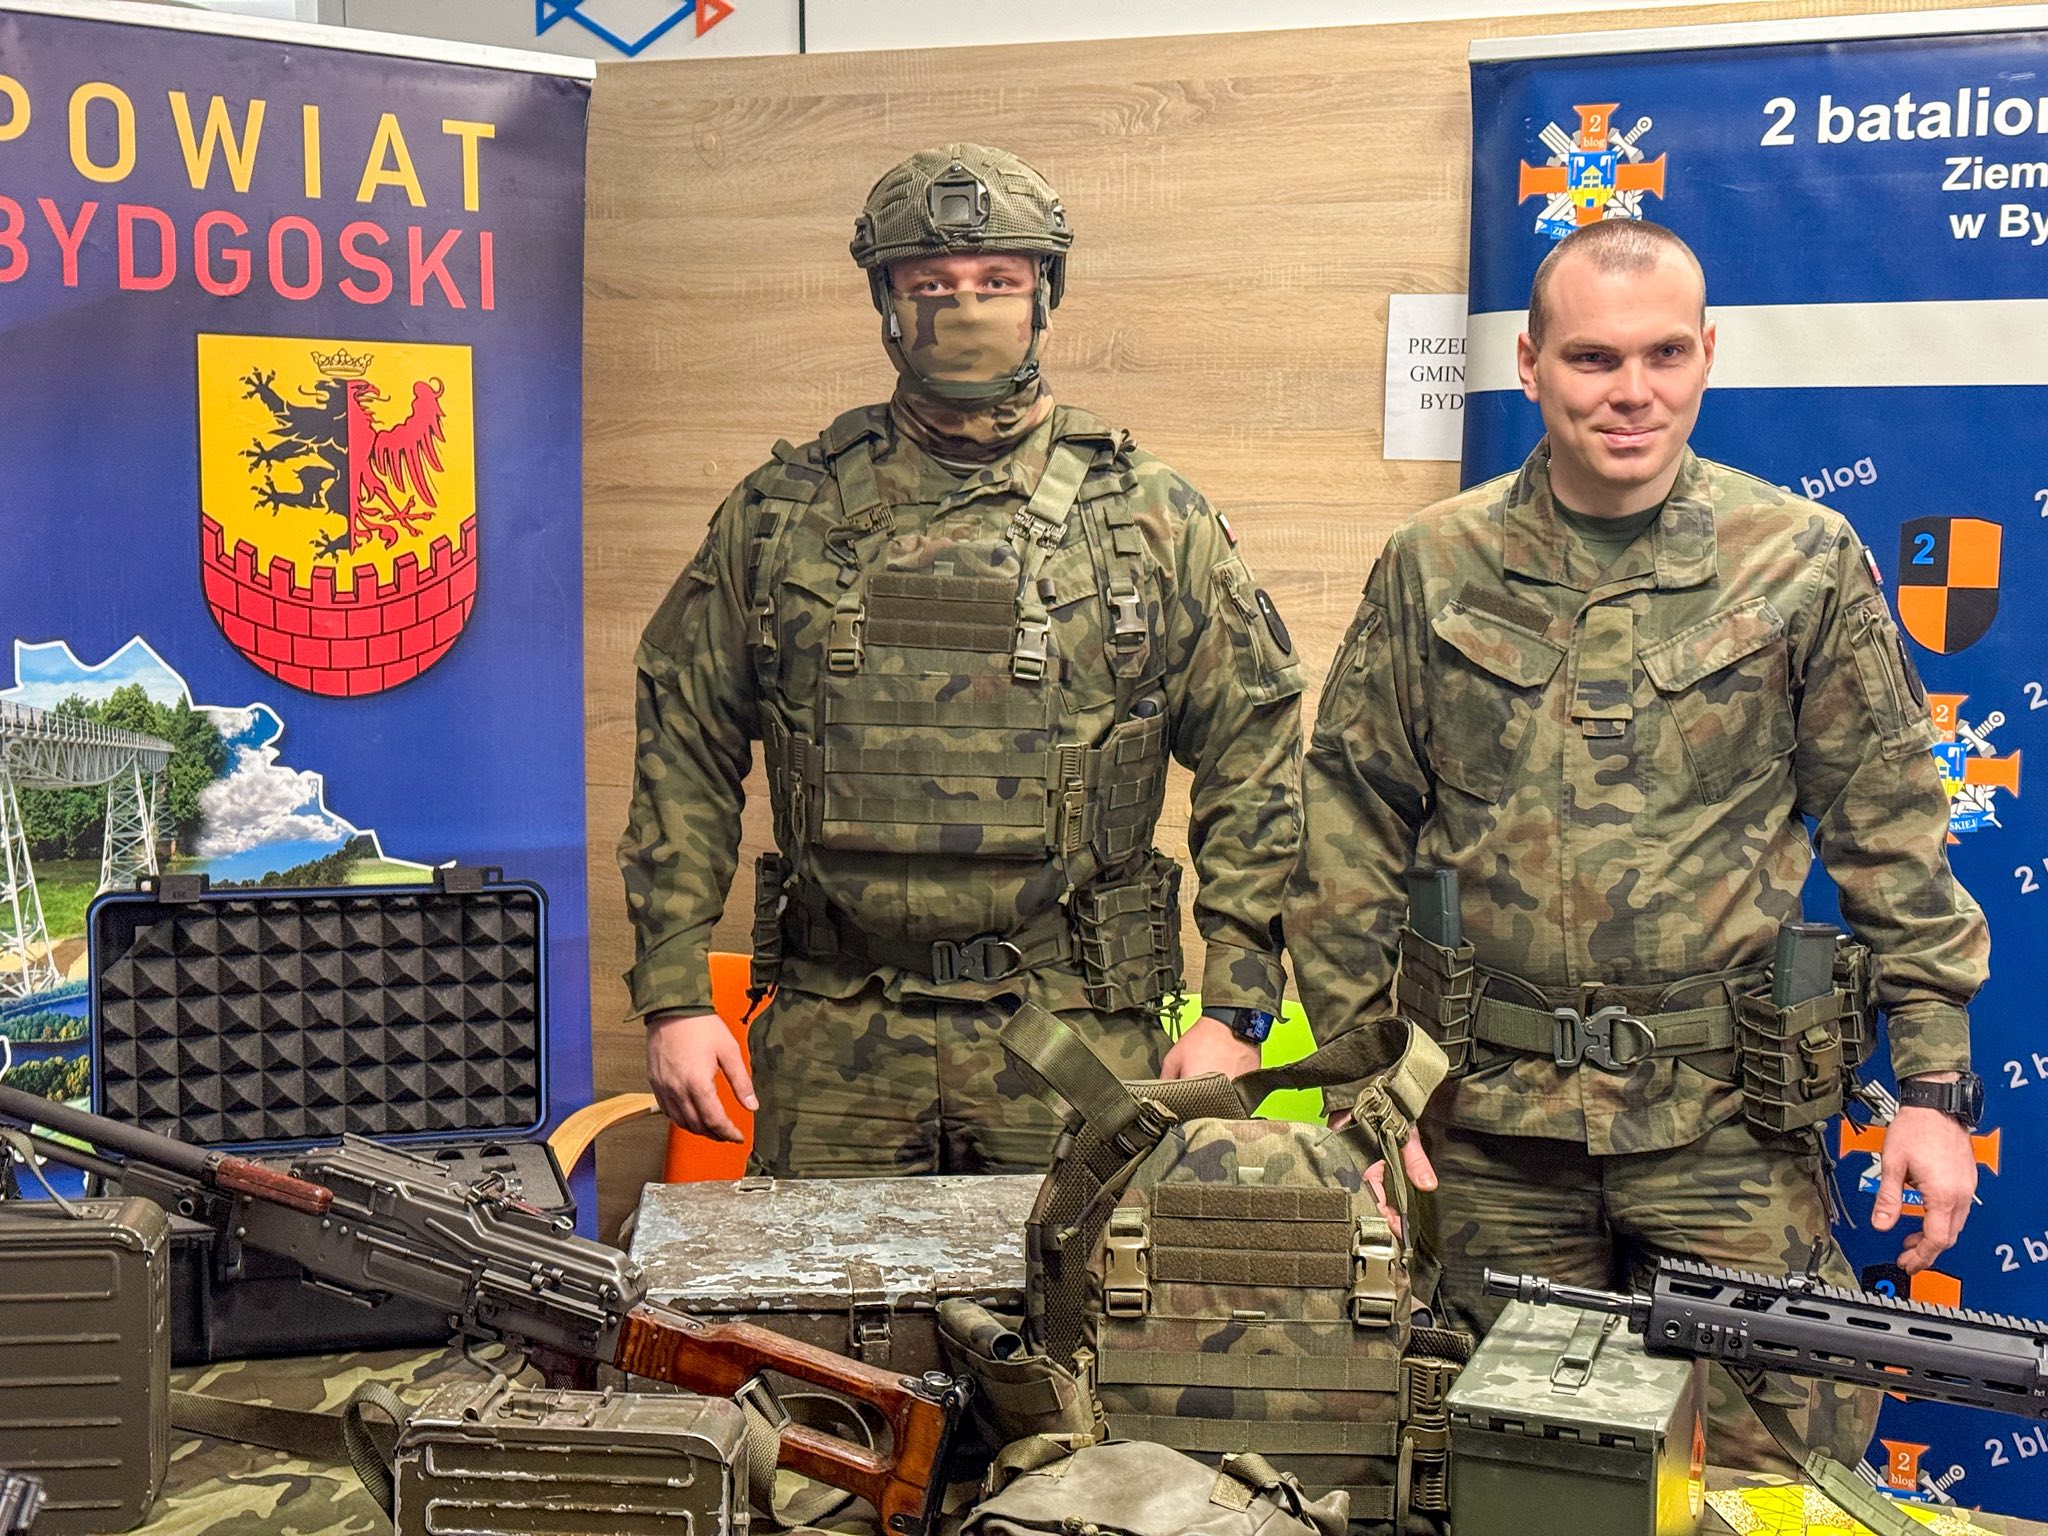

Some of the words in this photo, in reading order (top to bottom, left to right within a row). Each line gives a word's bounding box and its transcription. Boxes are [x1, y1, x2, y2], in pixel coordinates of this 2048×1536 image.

[1588, 114, 1602, 133] 2
[1760, 97, 1797, 146] 2
[1817, 87, 2048, 144] batalio
[1583, 136, 1606, 149] blog
[1942, 156, 2048, 191] Ziem
[1949, 213, 1987, 240] w
[0, 195, 495, 310] BYDGOSKI
[1410, 365, 1466, 383] GMIN
[1420, 393, 1464, 410] BYD
[1800, 456, 1878, 500] blog
[1912, 533, 1936, 565] 2
[2023, 681, 2048, 711] 2
[1935, 703, 1949, 723] 2
[2014, 865, 2040, 895] 2
[2003, 1060, 2029, 1089] 2
[1995, 1243, 2020, 1273] 2
[2022, 1231, 2048, 1264] b
[1984, 1438, 2010, 1468] 2
[2012, 1426, 2048, 1459] bl
[1897, 1452, 1911, 1472] 2
[1891, 1473, 1916, 1488] blog
